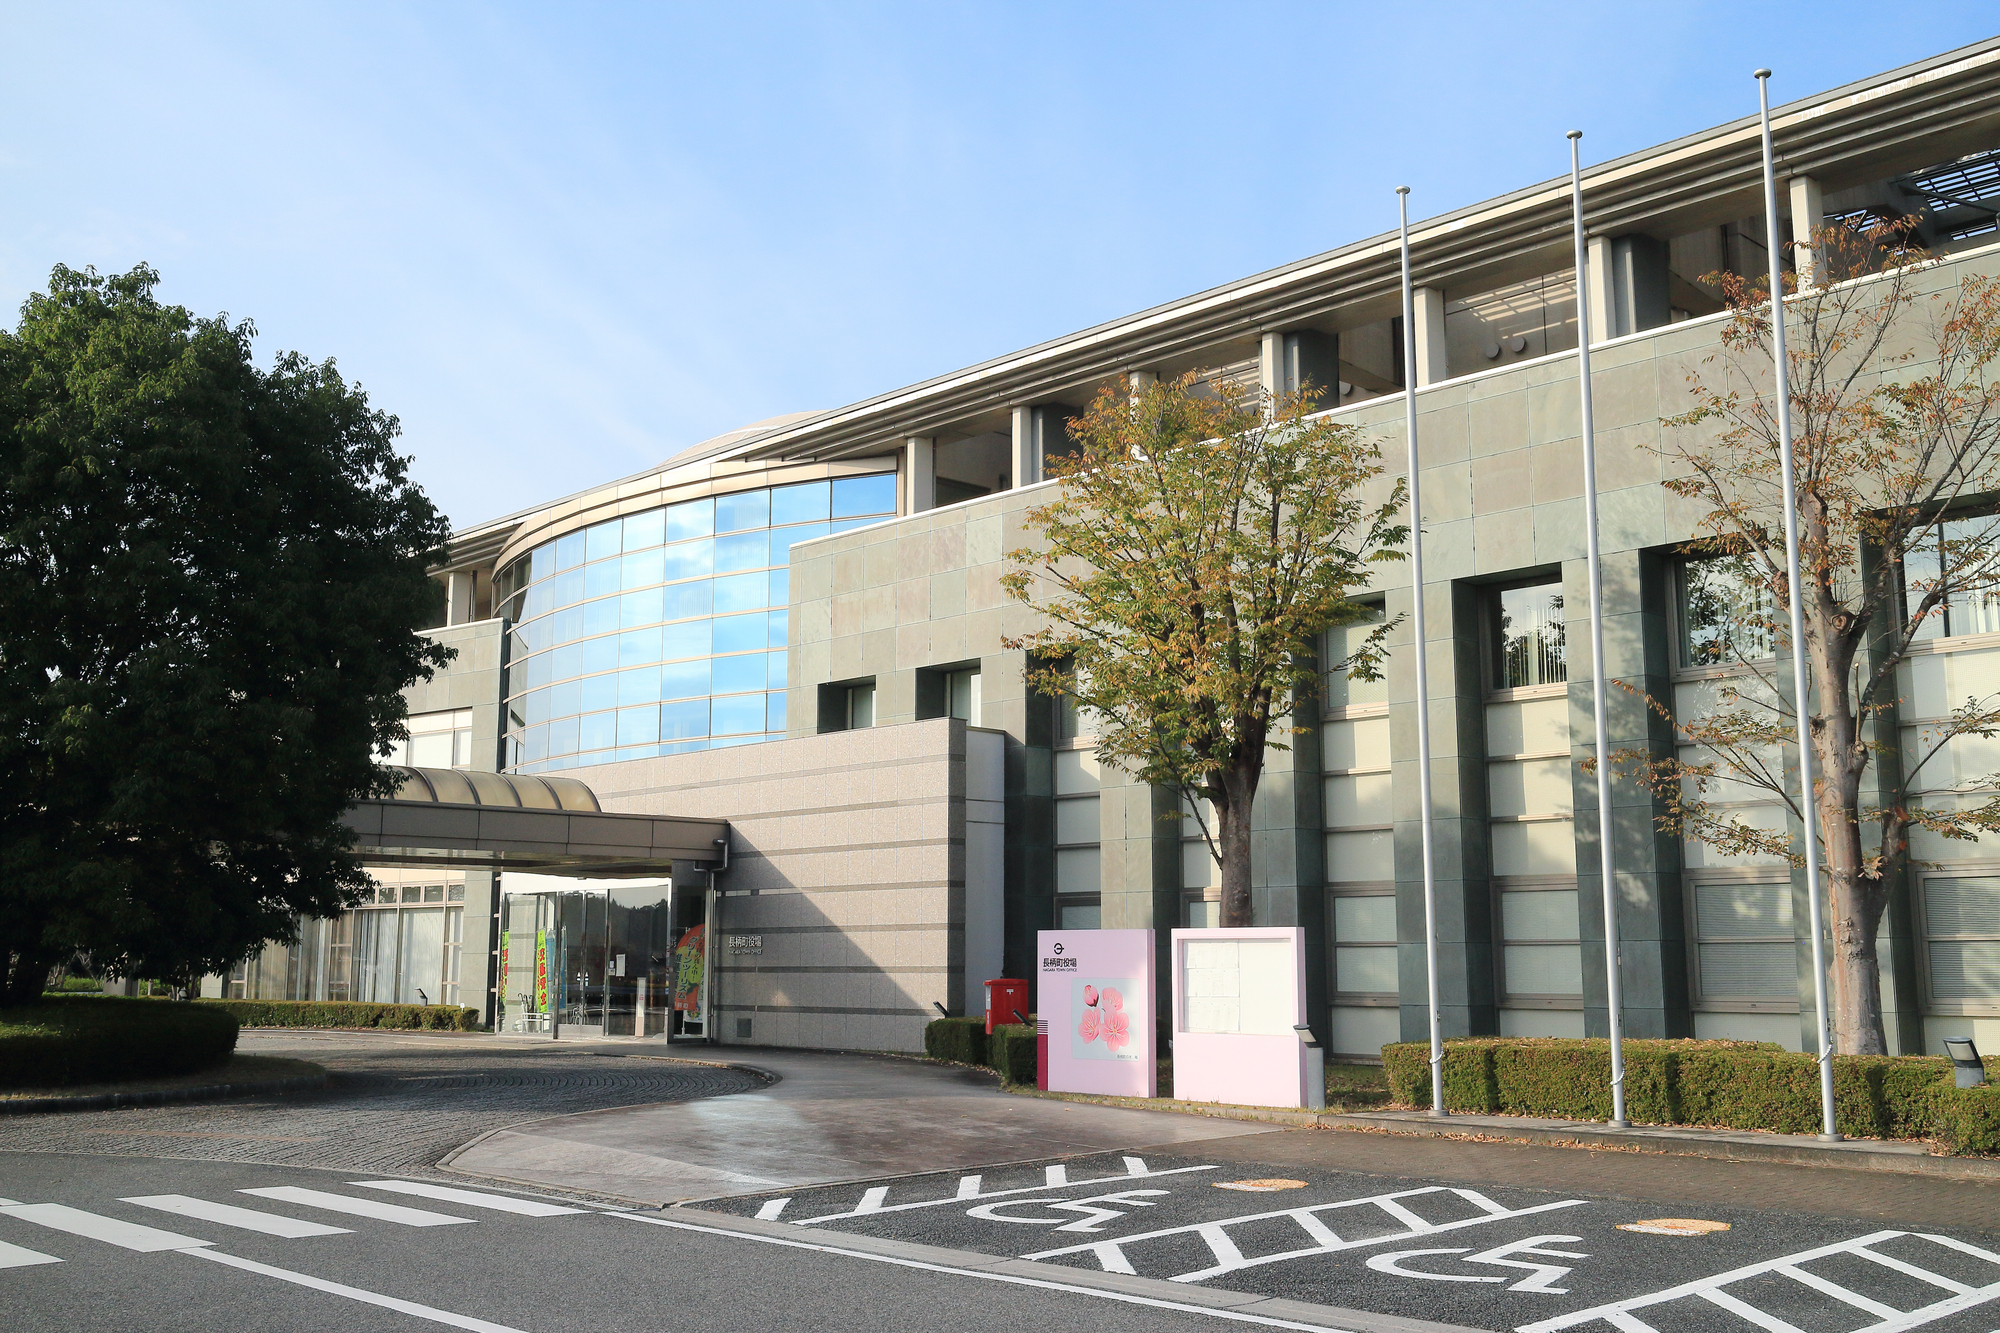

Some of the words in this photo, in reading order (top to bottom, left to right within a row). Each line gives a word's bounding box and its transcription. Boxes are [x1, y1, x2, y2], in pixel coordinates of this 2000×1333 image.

[729, 936, 762, 947] 長柄町役場
[677, 936, 699, 999] グリーンツーリズム
[1043, 957, 1077, 967] 長柄町役場
